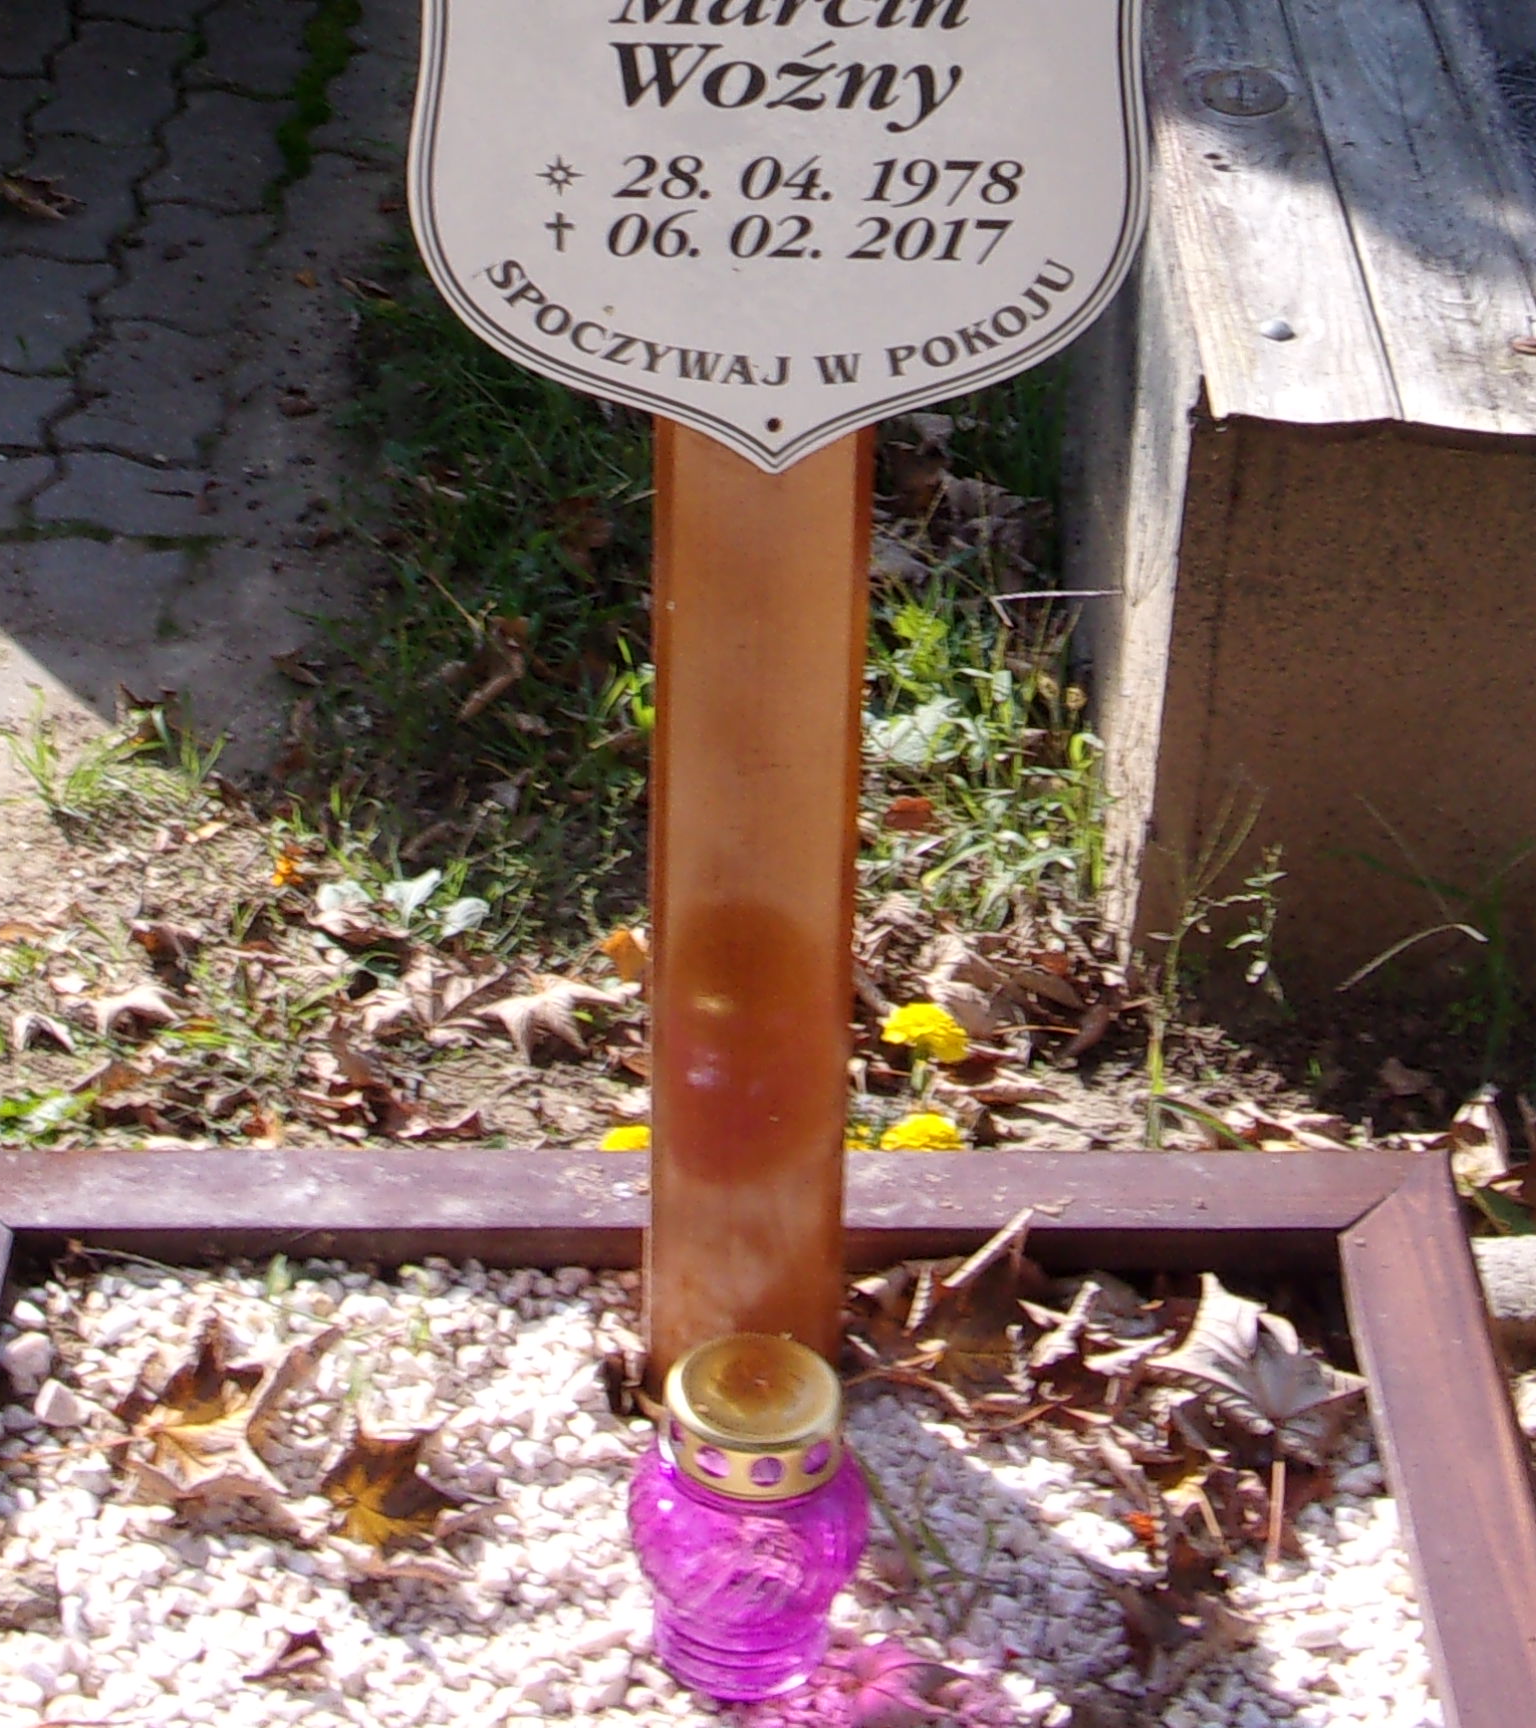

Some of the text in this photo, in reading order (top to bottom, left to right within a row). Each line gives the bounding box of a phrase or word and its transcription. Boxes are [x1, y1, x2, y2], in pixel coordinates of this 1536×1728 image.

[608, 39, 964, 134] Woźny
[860, 157, 1025, 208] 1978
[845, 215, 1014, 266] 2017
[484, 257, 1077, 388] SPOCZYWAJ W POKOJU
